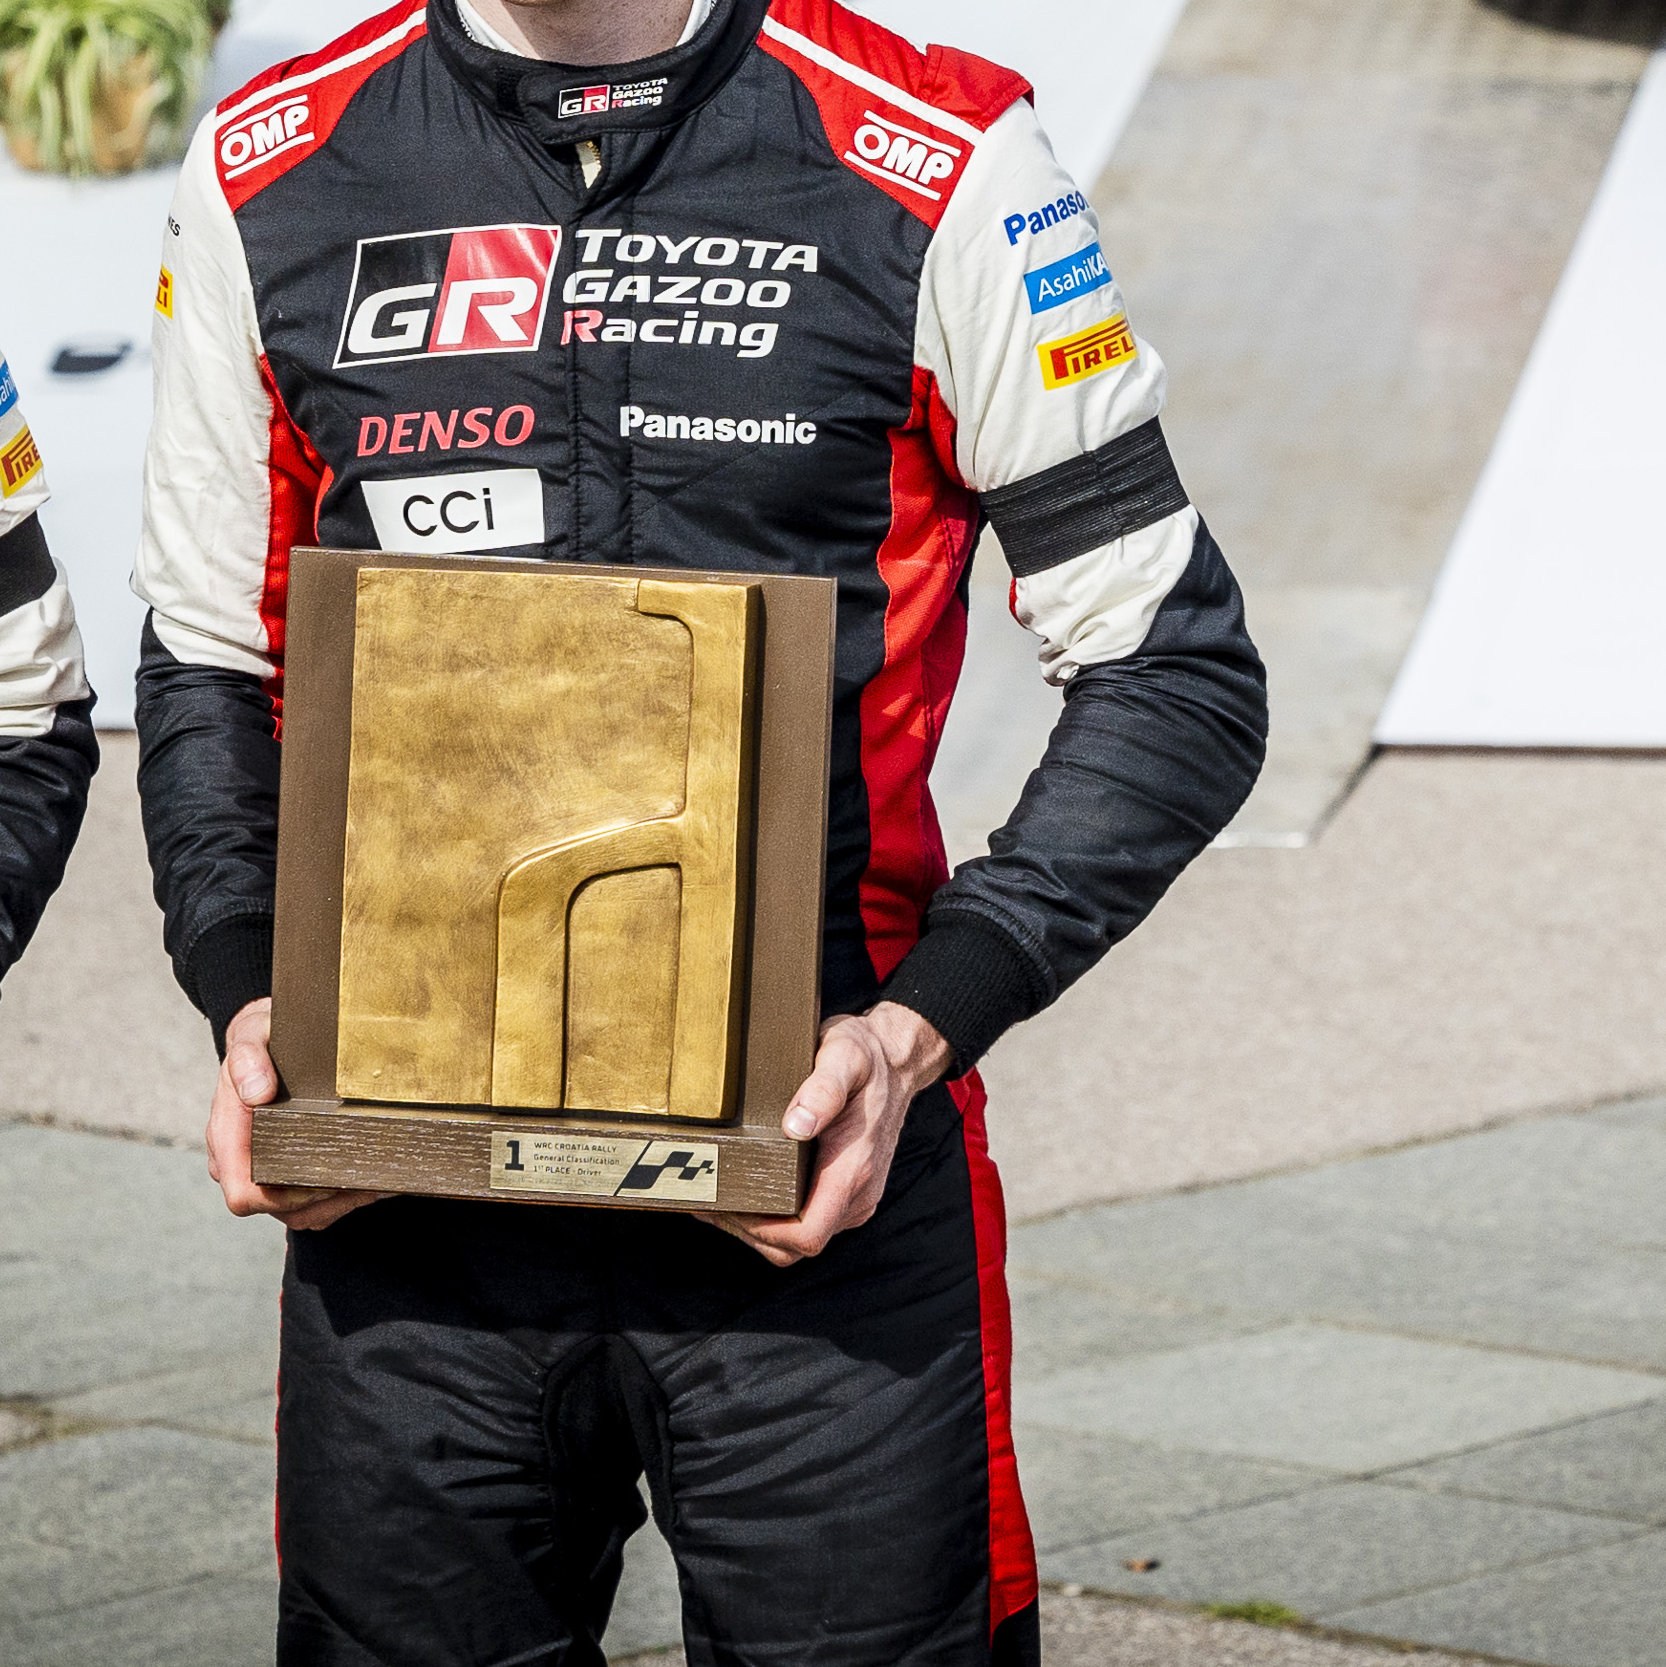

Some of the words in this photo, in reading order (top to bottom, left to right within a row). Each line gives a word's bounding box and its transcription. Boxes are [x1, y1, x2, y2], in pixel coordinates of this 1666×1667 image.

[612, 86, 664, 100] GAZOO
[612, 95, 663, 109] Racing
[613, 77, 669, 91] TOYOTA
[561, 95, 607, 115] GR
[221, 101, 310, 167] OMP
[853, 123, 955, 186] OMP
[576, 228, 819, 274] TOYOTA
[562, 269, 792, 309] GAZOO
[346, 277, 538, 355] GR
[560, 309, 780, 359] Racing
[357, 404, 536, 457] DENSO
[619, 405, 817, 445] Panasonic
[402, 486, 496, 537] CCi
[504, 1139, 525, 1172] 1
[533, 1153, 565, 1162] General
[566, 1155, 620, 1166] Classification
[554, 1143, 590, 1151] CROATIA
[591, 1145, 618, 1153] RALLY
[545, 1166, 571, 1174] PLACE
[577, 1168, 603, 1176] Driver
